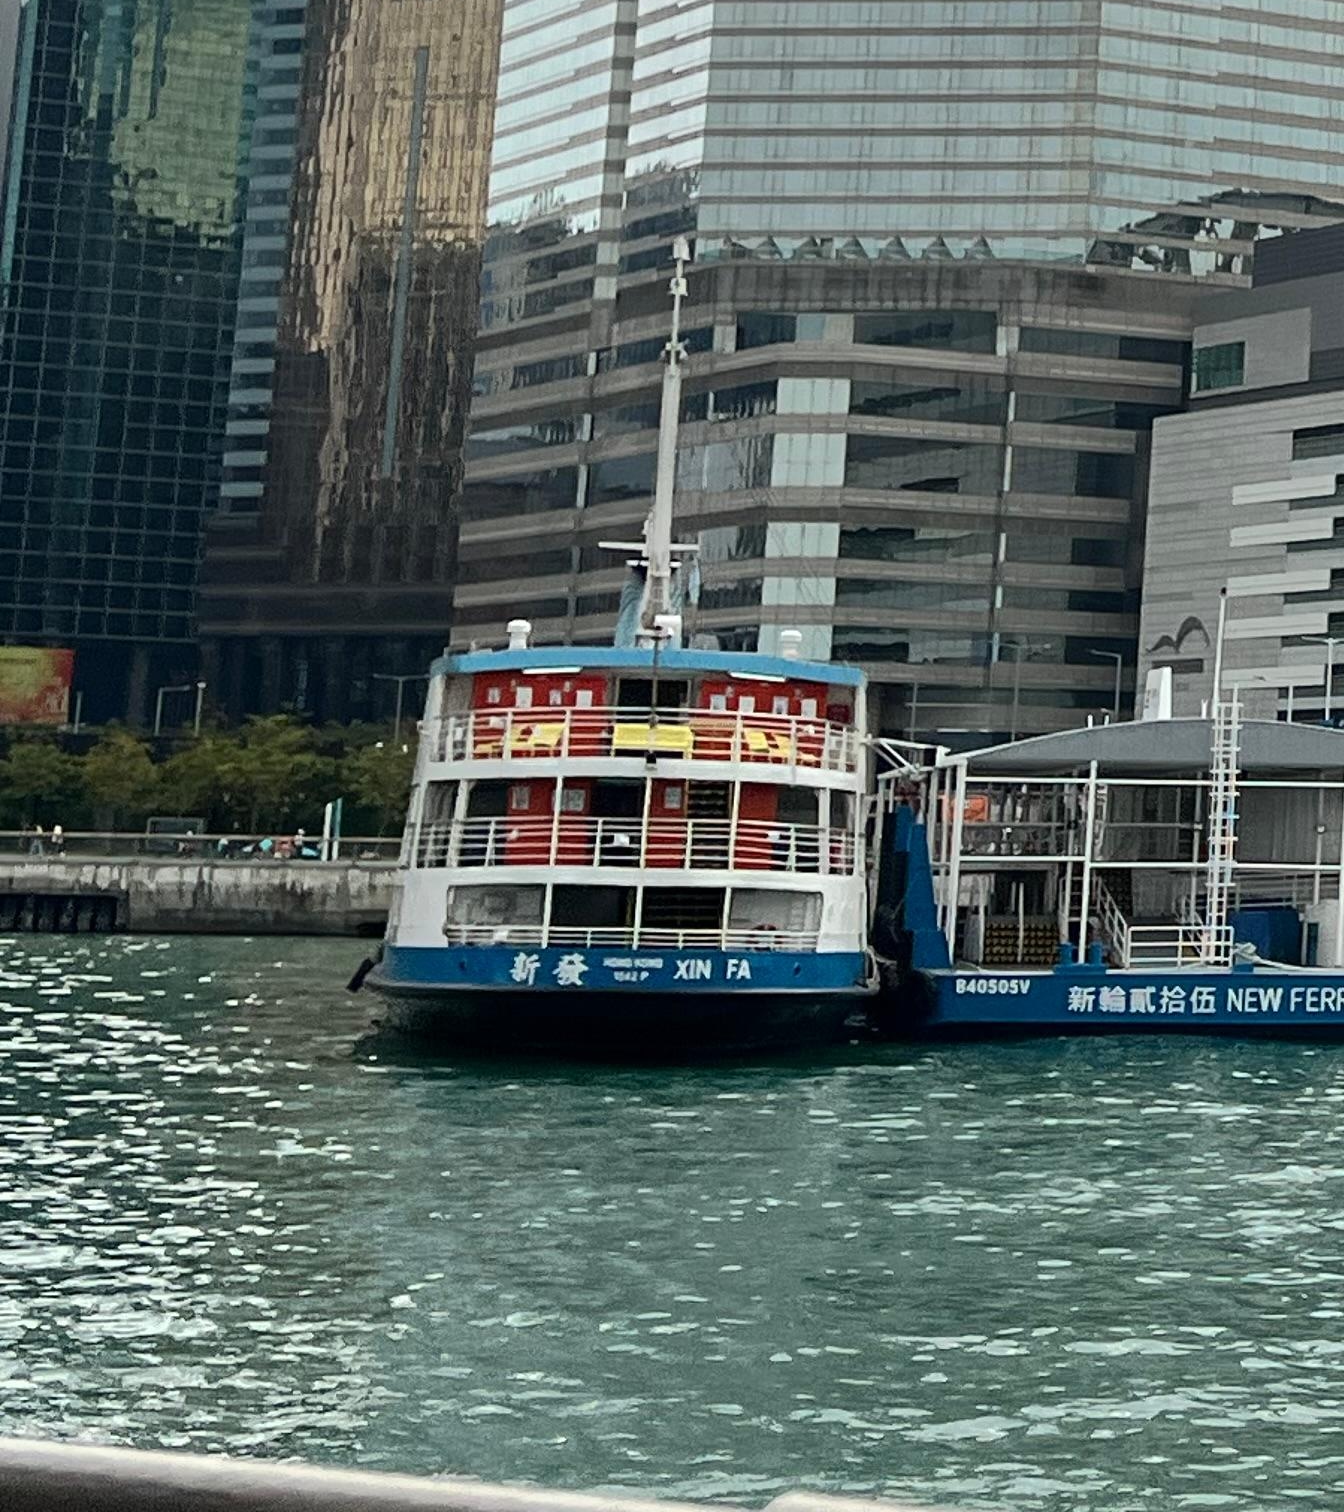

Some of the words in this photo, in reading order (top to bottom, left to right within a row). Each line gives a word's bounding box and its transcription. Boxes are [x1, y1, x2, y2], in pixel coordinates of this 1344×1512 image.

[673, 959, 712, 980] XIN
[726, 959, 751, 979] FA
[1226, 987, 1284, 1013] NEW
